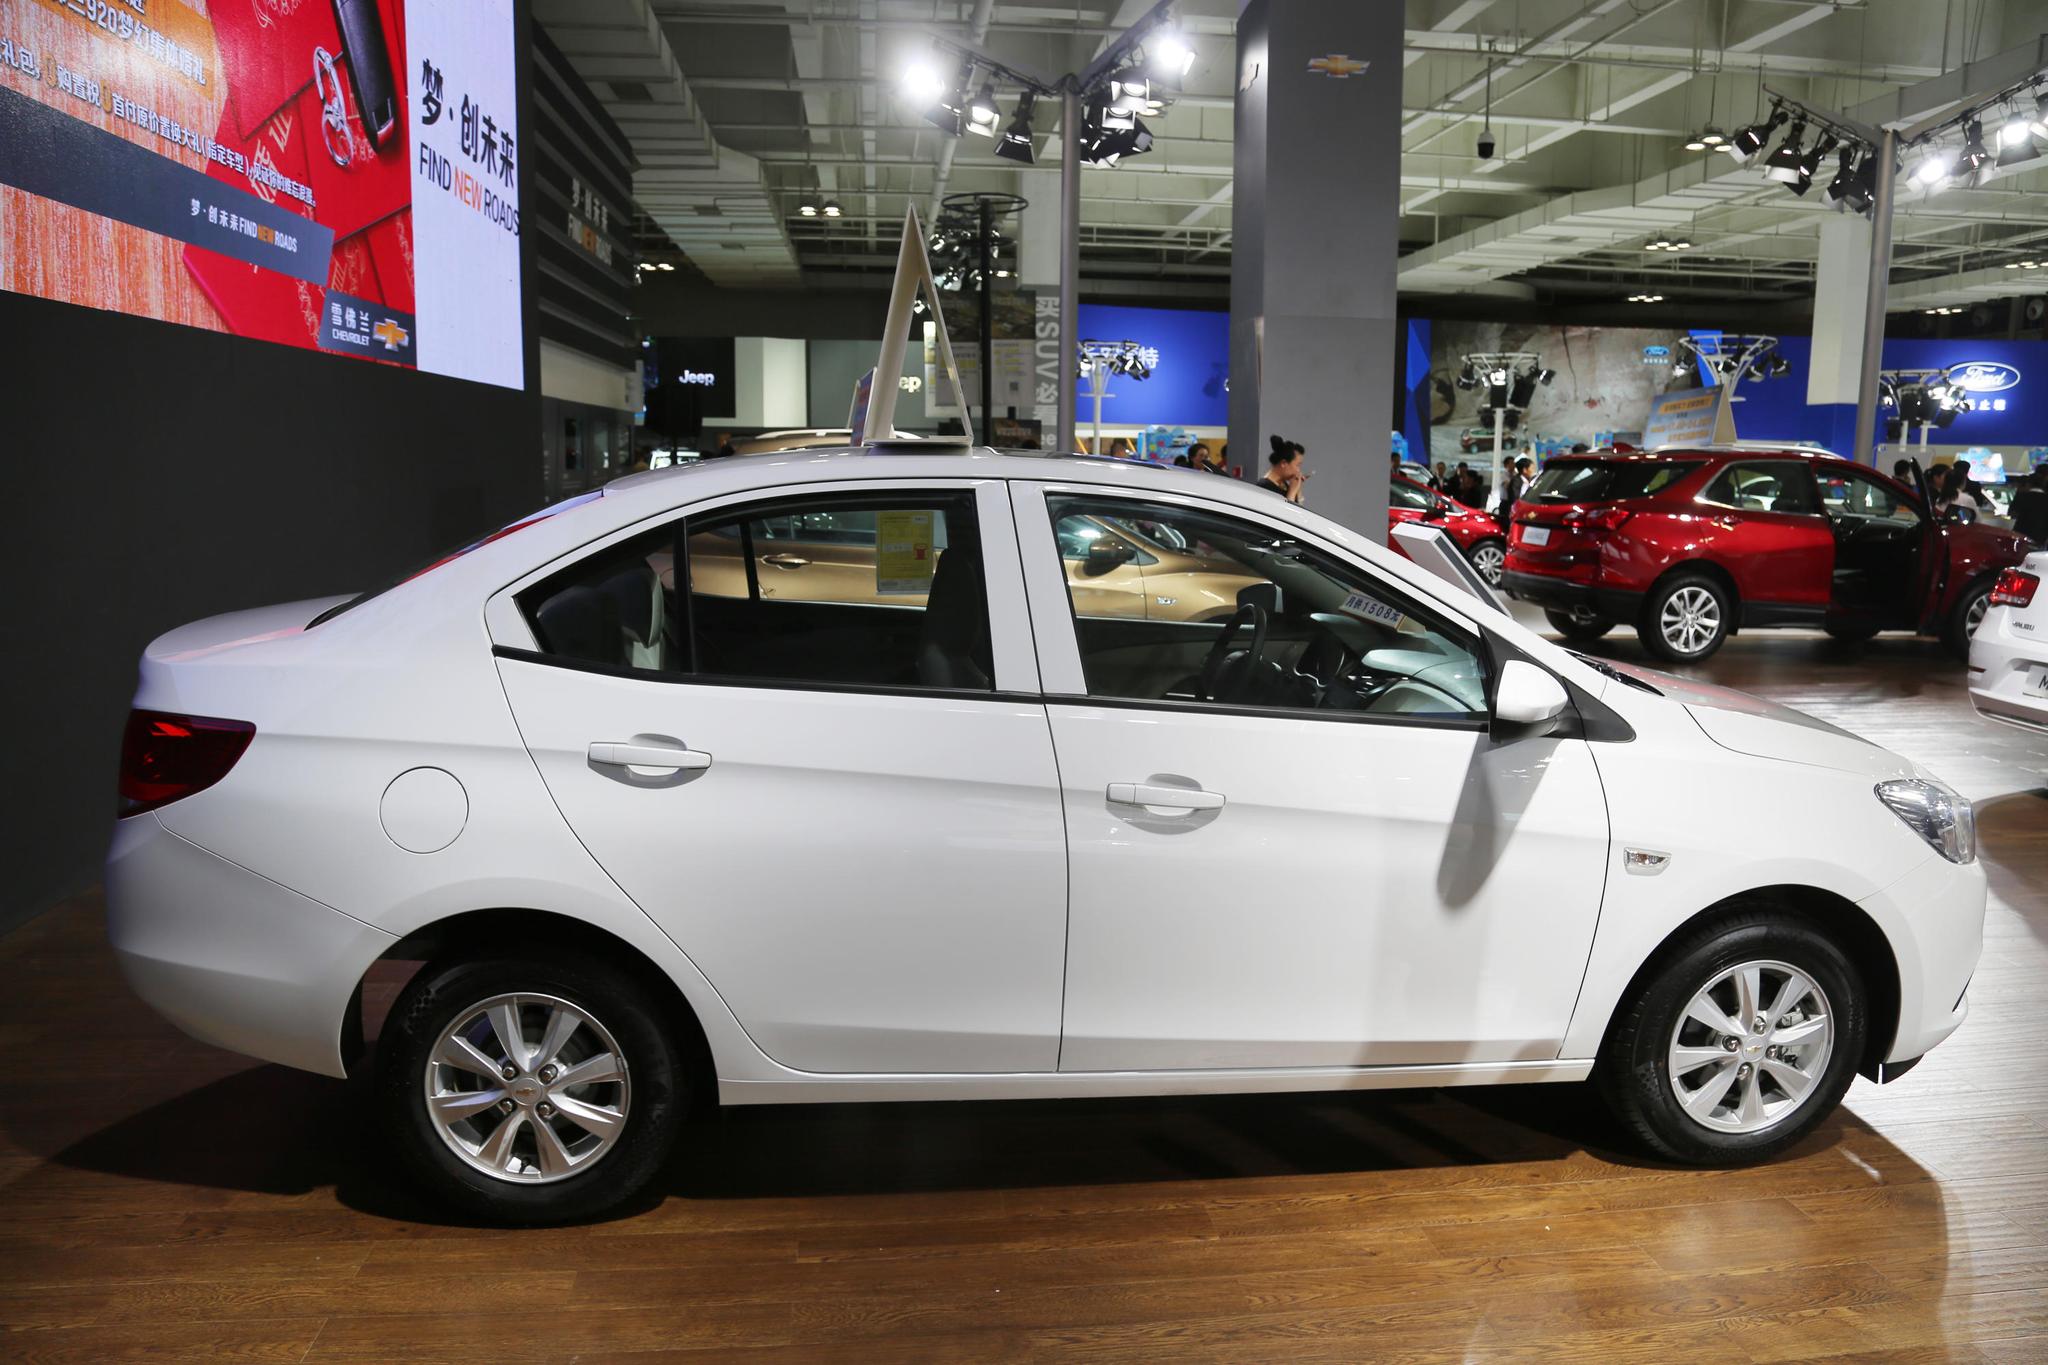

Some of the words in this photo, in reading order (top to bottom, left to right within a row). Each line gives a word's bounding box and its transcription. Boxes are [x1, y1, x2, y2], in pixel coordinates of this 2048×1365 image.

[421, 58, 514, 188] 梦·创未来
[420, 142, 451, 190] FIND
[454, 166, 483, 212] NEW
[484, 188, 520, 236] ROADS
[239, 217, 258, 241] FIND
[275, 232, 298, 253] ROADS
[331, 328, 370, 347] CHEVROLET
[678, 370, 715, 386] Jeep
[899, 375, 922, 393] ep
